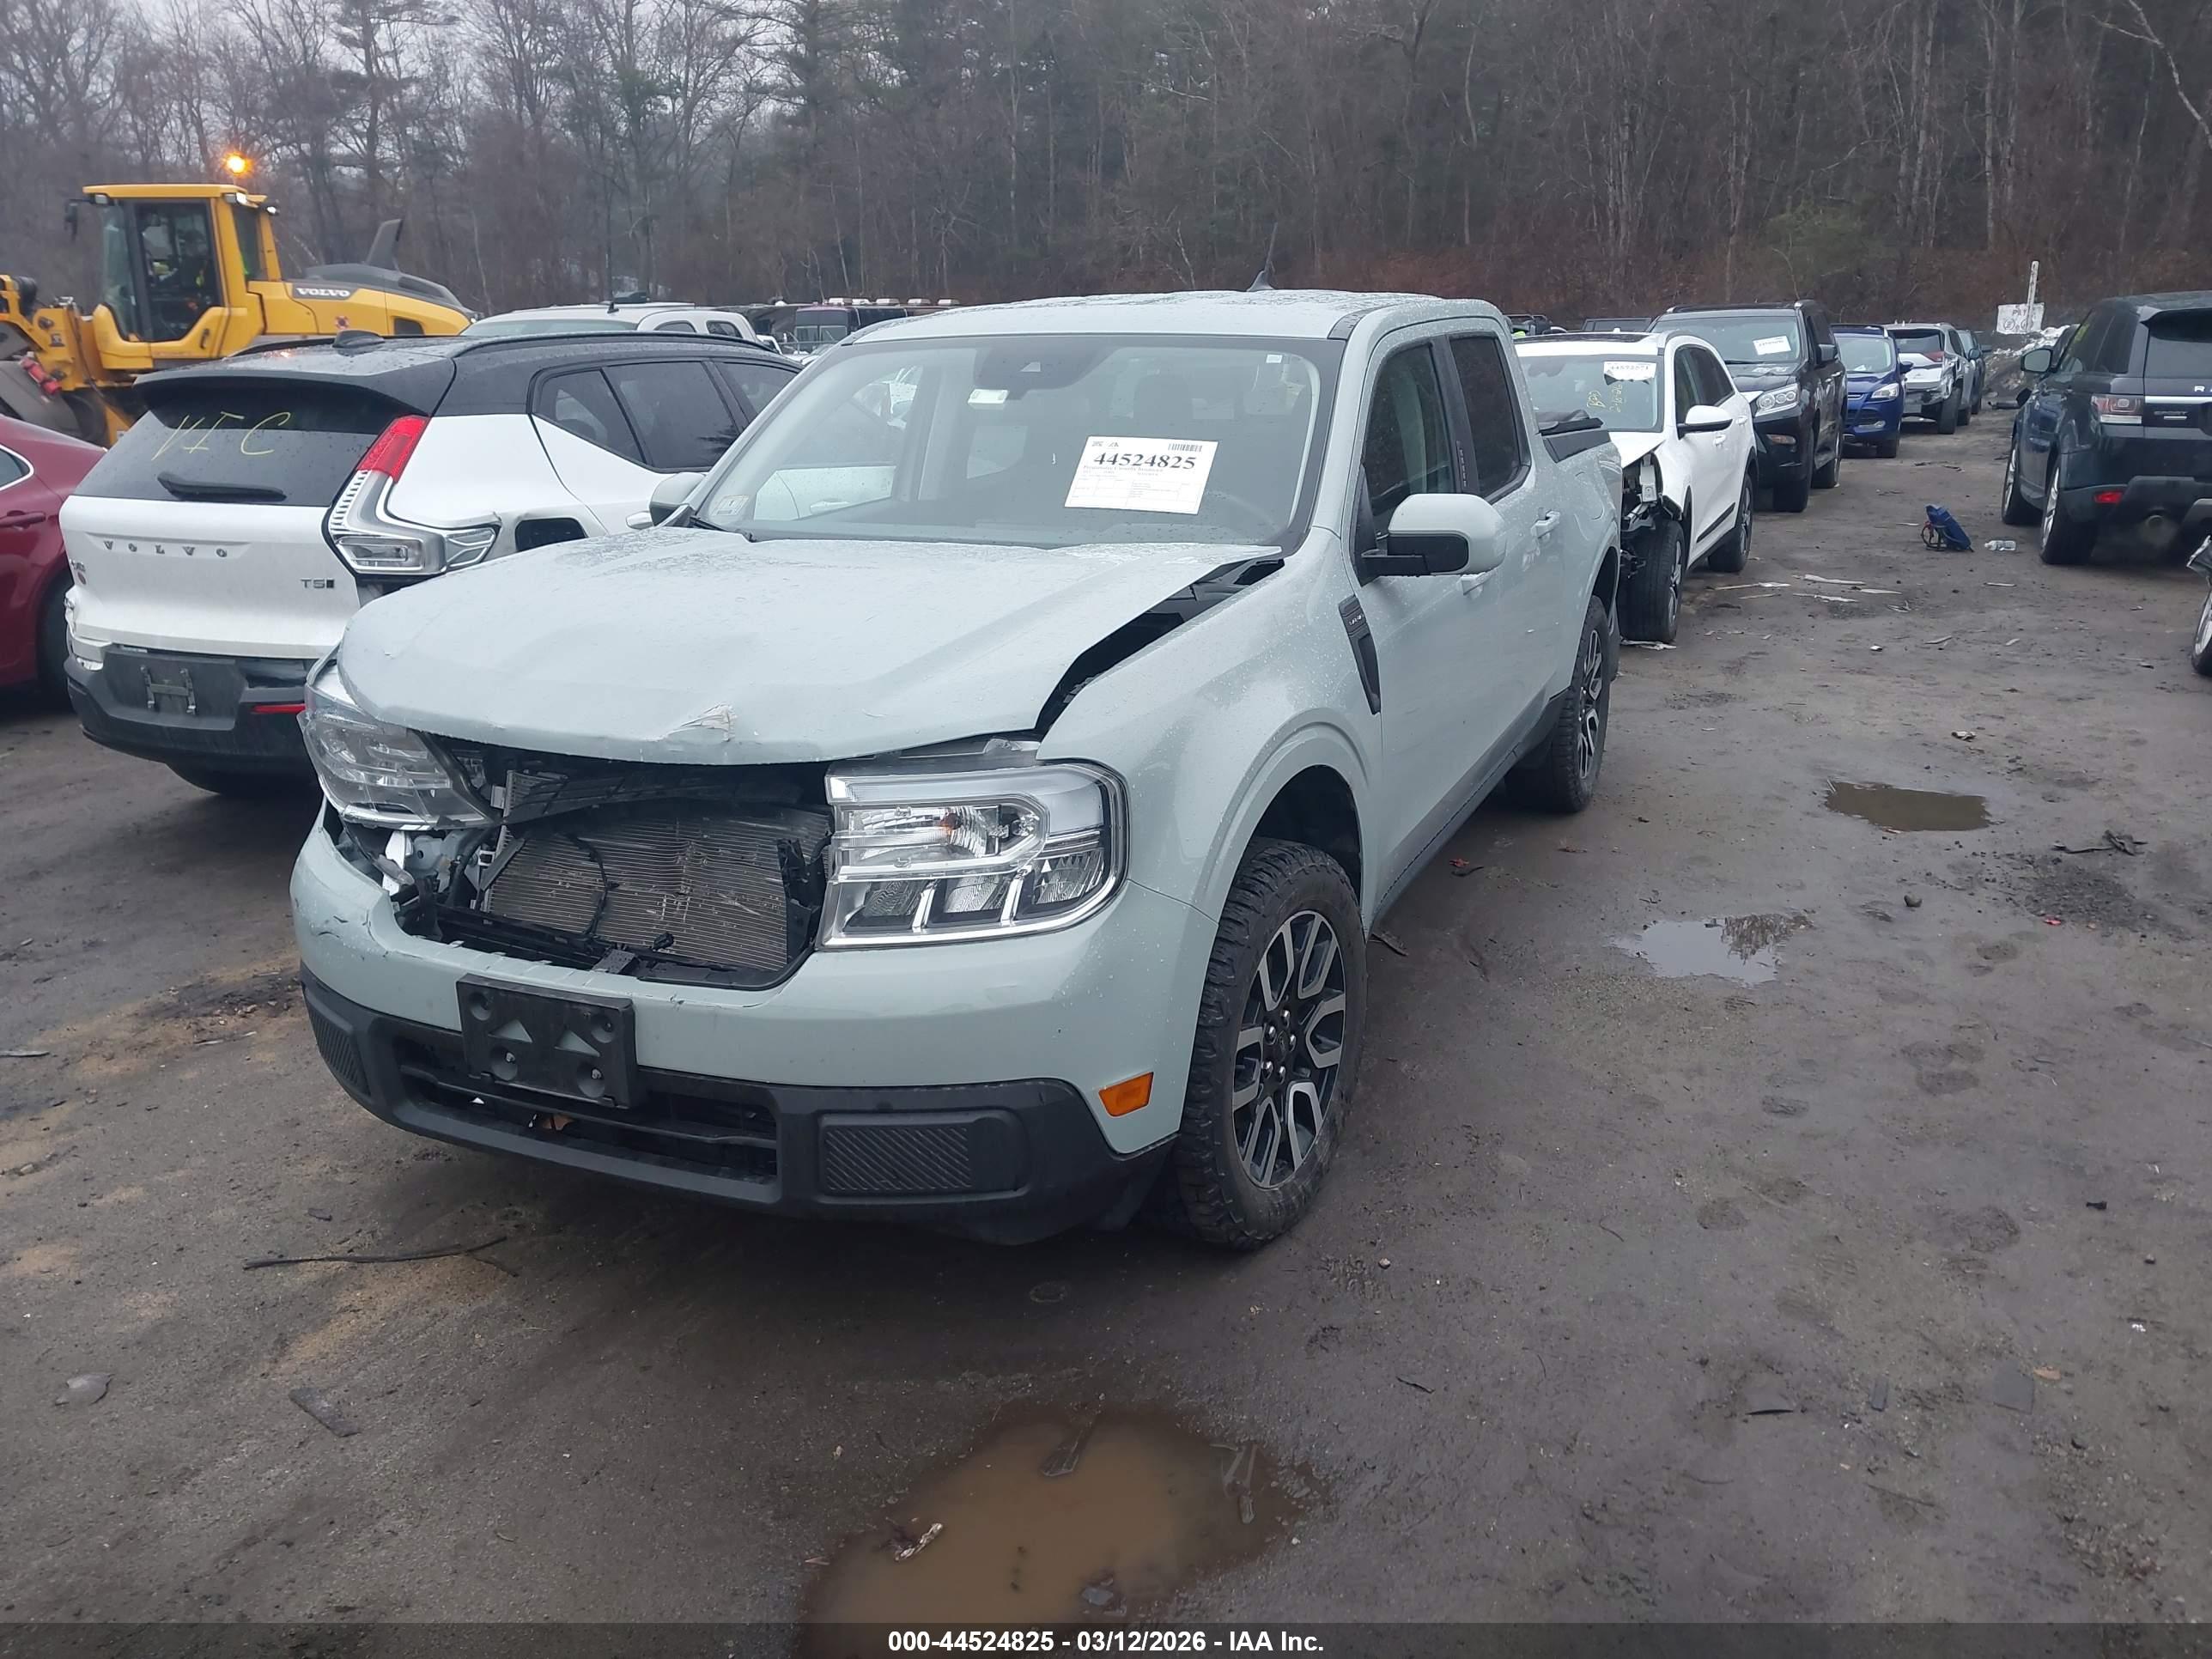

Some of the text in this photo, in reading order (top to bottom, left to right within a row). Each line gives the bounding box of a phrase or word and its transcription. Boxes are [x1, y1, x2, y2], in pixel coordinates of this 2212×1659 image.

[295, 287, 351, 297] VOLVO
[1093, 453, 1197, 470] 44524825
[103, 539, 228, 558] VOLVO
